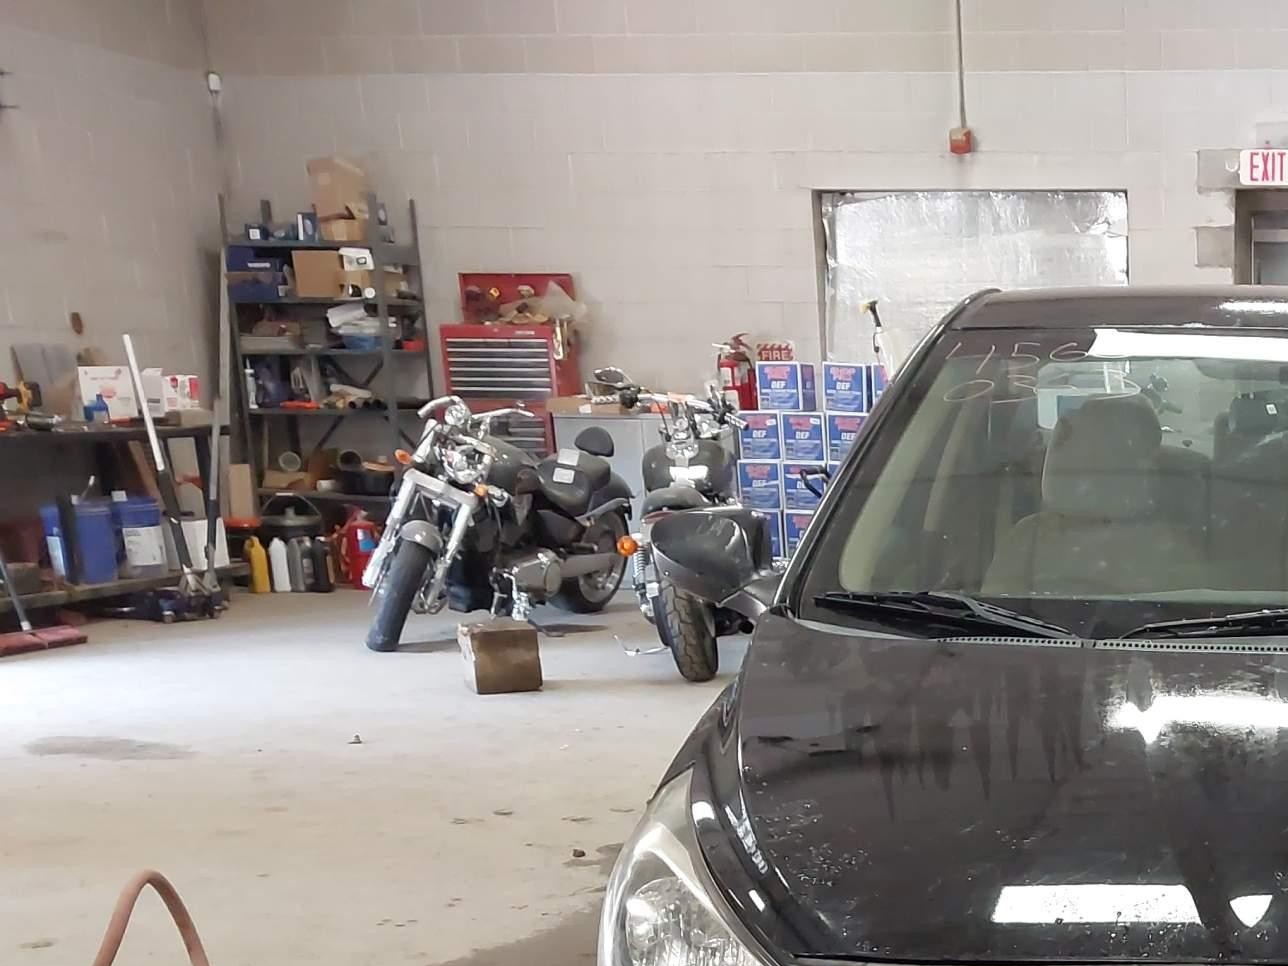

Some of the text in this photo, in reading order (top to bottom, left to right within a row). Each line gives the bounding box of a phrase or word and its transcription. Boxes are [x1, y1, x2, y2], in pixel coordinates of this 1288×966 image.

[1250, 152, 1286, 181] EXIT
[761, 350, 792, 361] FIRE
[771, 380, 786, 389] DEF
[836, 382, 851, 390] DEF
[752, 430, 767, 438] DEF
[795, 431, 810, 439] DEF
